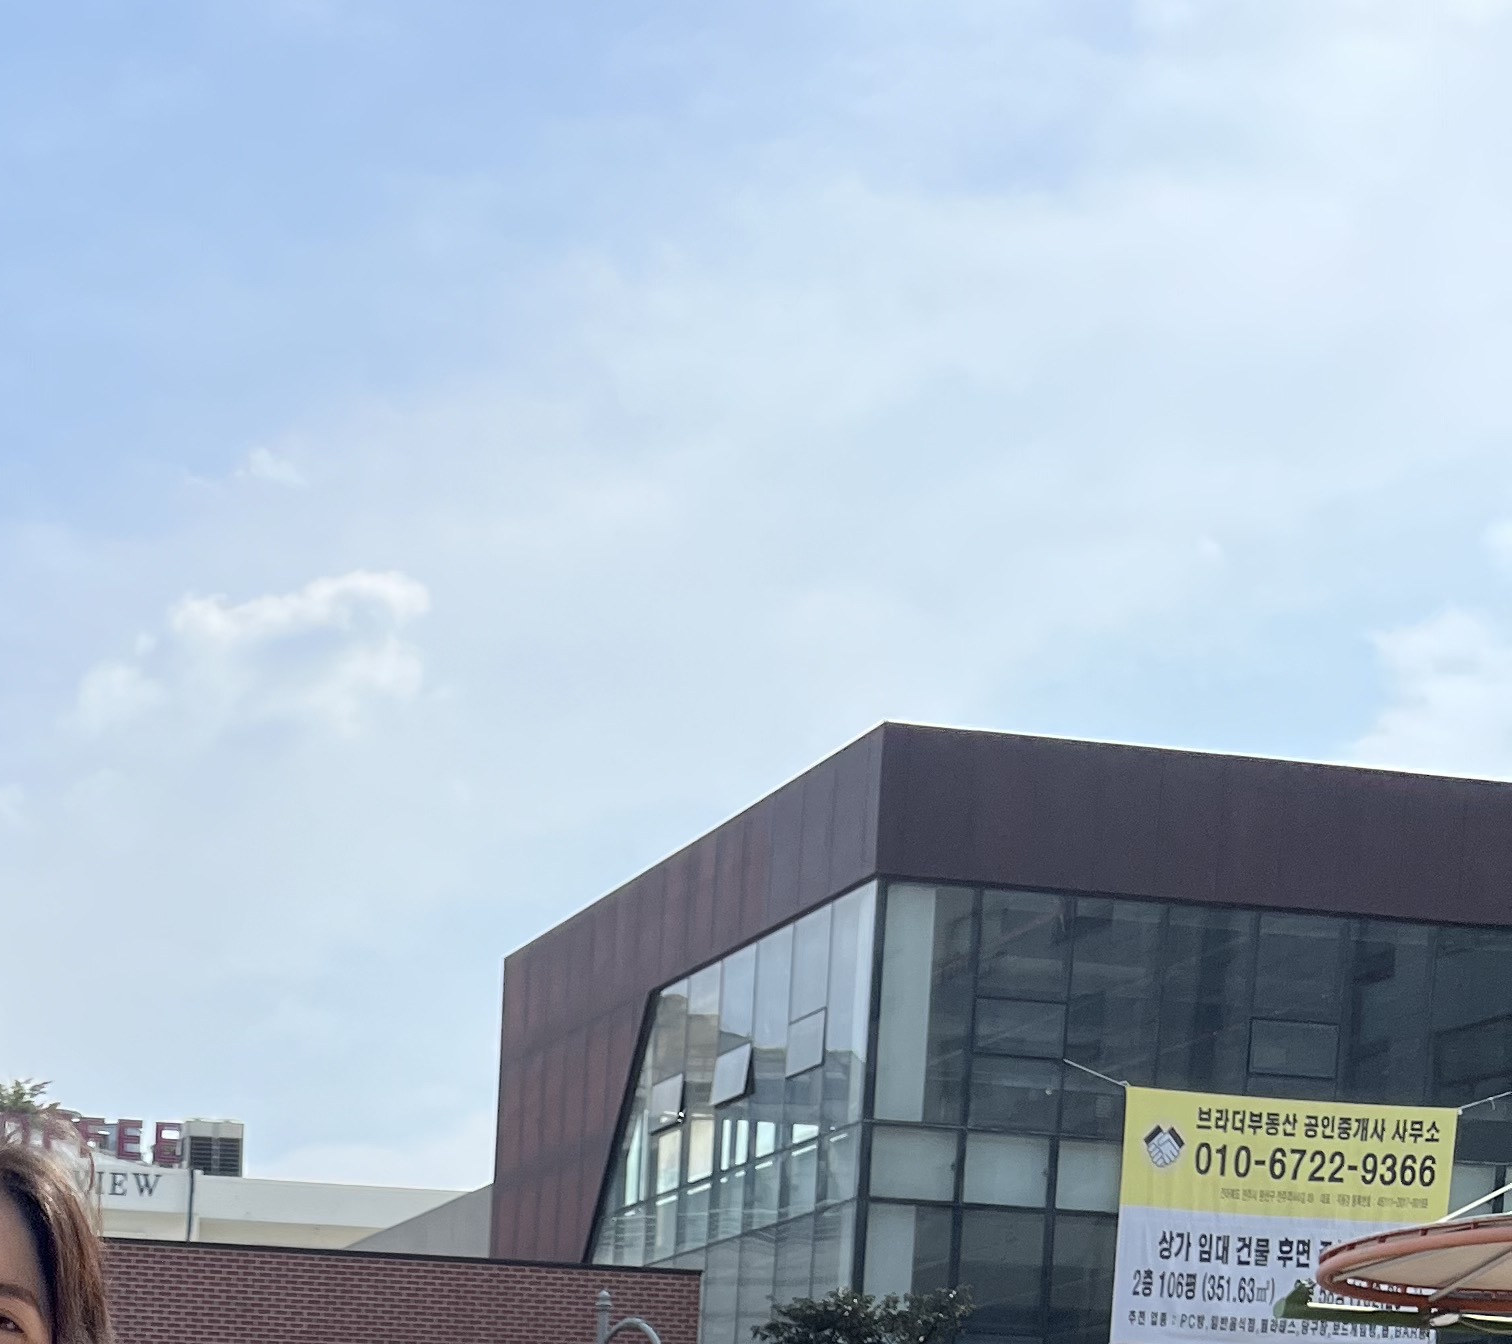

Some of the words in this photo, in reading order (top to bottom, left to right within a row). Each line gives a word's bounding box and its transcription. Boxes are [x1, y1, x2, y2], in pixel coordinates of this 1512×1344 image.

[1196, 1107, 1299, 1137] 브라더부동산
[1304, 1114, 1386, 1143] 공인중개사
[1392, 1119, 1441, 1144] 사무소
[1195, 1142, 1437, 1187] 010-6722-9366
[1158, 1230, 1192, 1262] 상가
[1198, 1233, 1231, 1265] 임대
[1236, 1236, 1270, 1268] 건물
[1277, 1238, 1311, 1268] 후면
[1132, 1268, 1154, 1298] 2층
[1159, 1271, 1198, 1300] 106평
